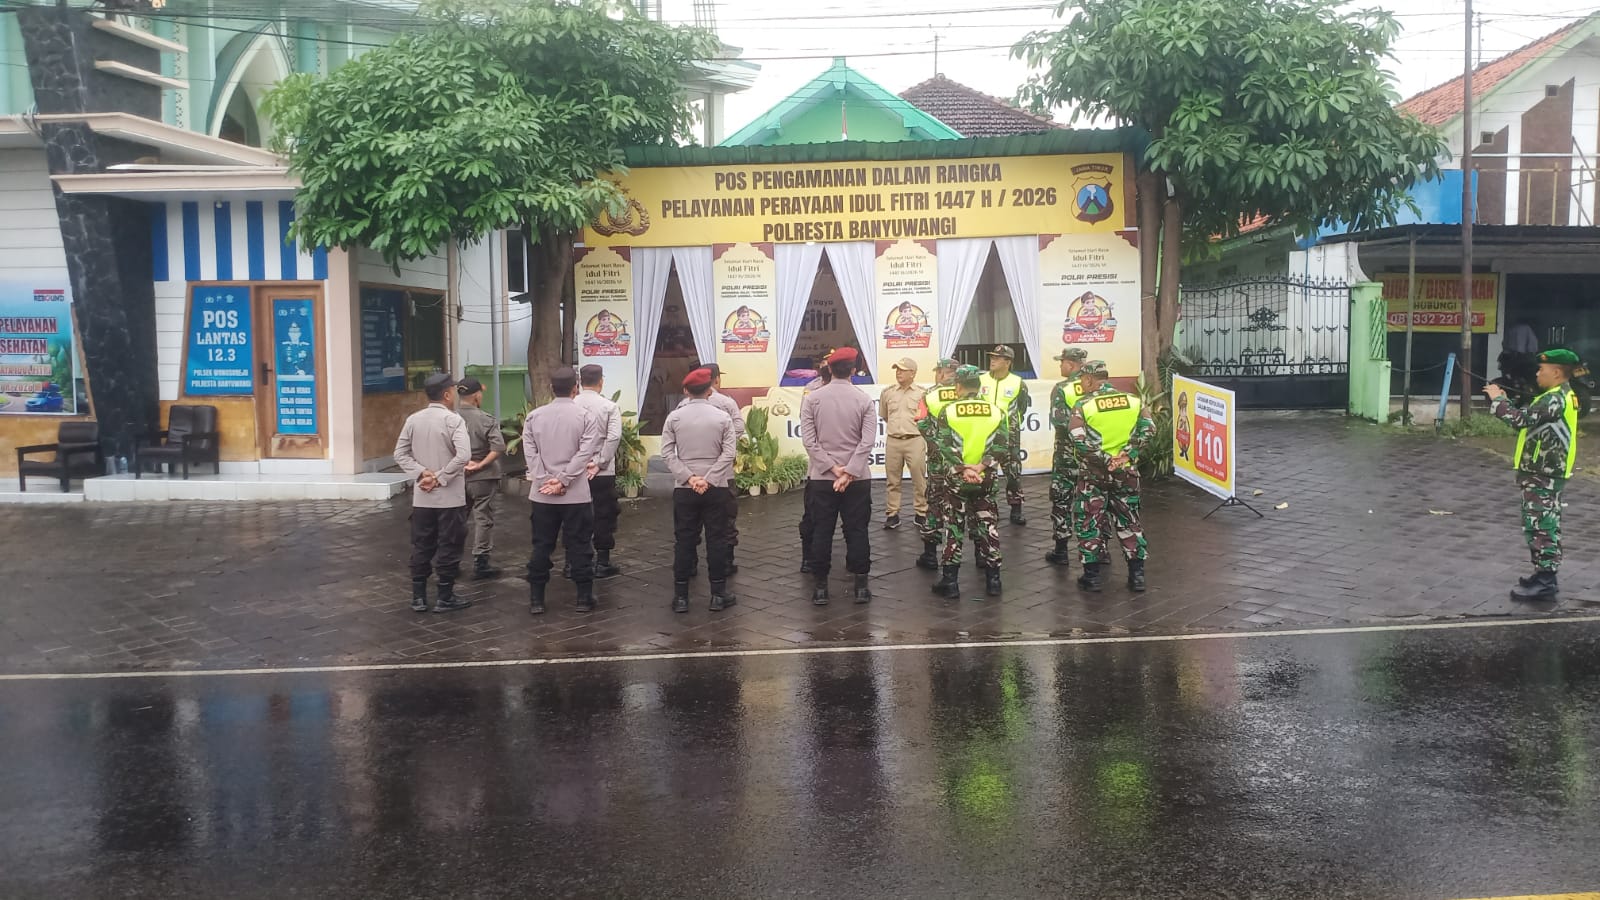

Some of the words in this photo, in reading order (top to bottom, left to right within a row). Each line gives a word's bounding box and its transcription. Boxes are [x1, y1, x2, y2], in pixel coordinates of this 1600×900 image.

[715, 172, 747, 191] POS
[752, 168, 867, 190] PENGAMANAN
[872, 166, 931, 186] DALAM
[936, 163, 1002, 184] RANGKA
[662, 198, 755, 218] PELAYANAN
[760, 195, 844, 216] PERAYAAN
[849, 193, 885, 212] IDUL
[890, 192, 929, 211] FITRI
[934, 190, 975, 210] 1447
[981, 189, 992, 208] H
[998, 188, 1006, 207] /
[1012, 187, 1057, 207] 2026
[763, 221, 844, 241] POLRESTA
[849, 217, 957, 239] BANYUWANGI
[1072, 254, 1087, 262] Idul
[890, 261, 905, 269] Idul
[585, 270, 601, 278] Idul
[603, 269, 620, 277] Fitri
[1413, 301, 1457, 310] HUBUNGI
[0, 317, 58, 333] PELAYANAN
[203, 310, 238, 328] POS
[196, 332, 247, 345] LANTAS
[958, 403, 990, 416] 0825
[1098, 397, 1128, 410] 0825
[1196, 428, 1224, 465] 110
